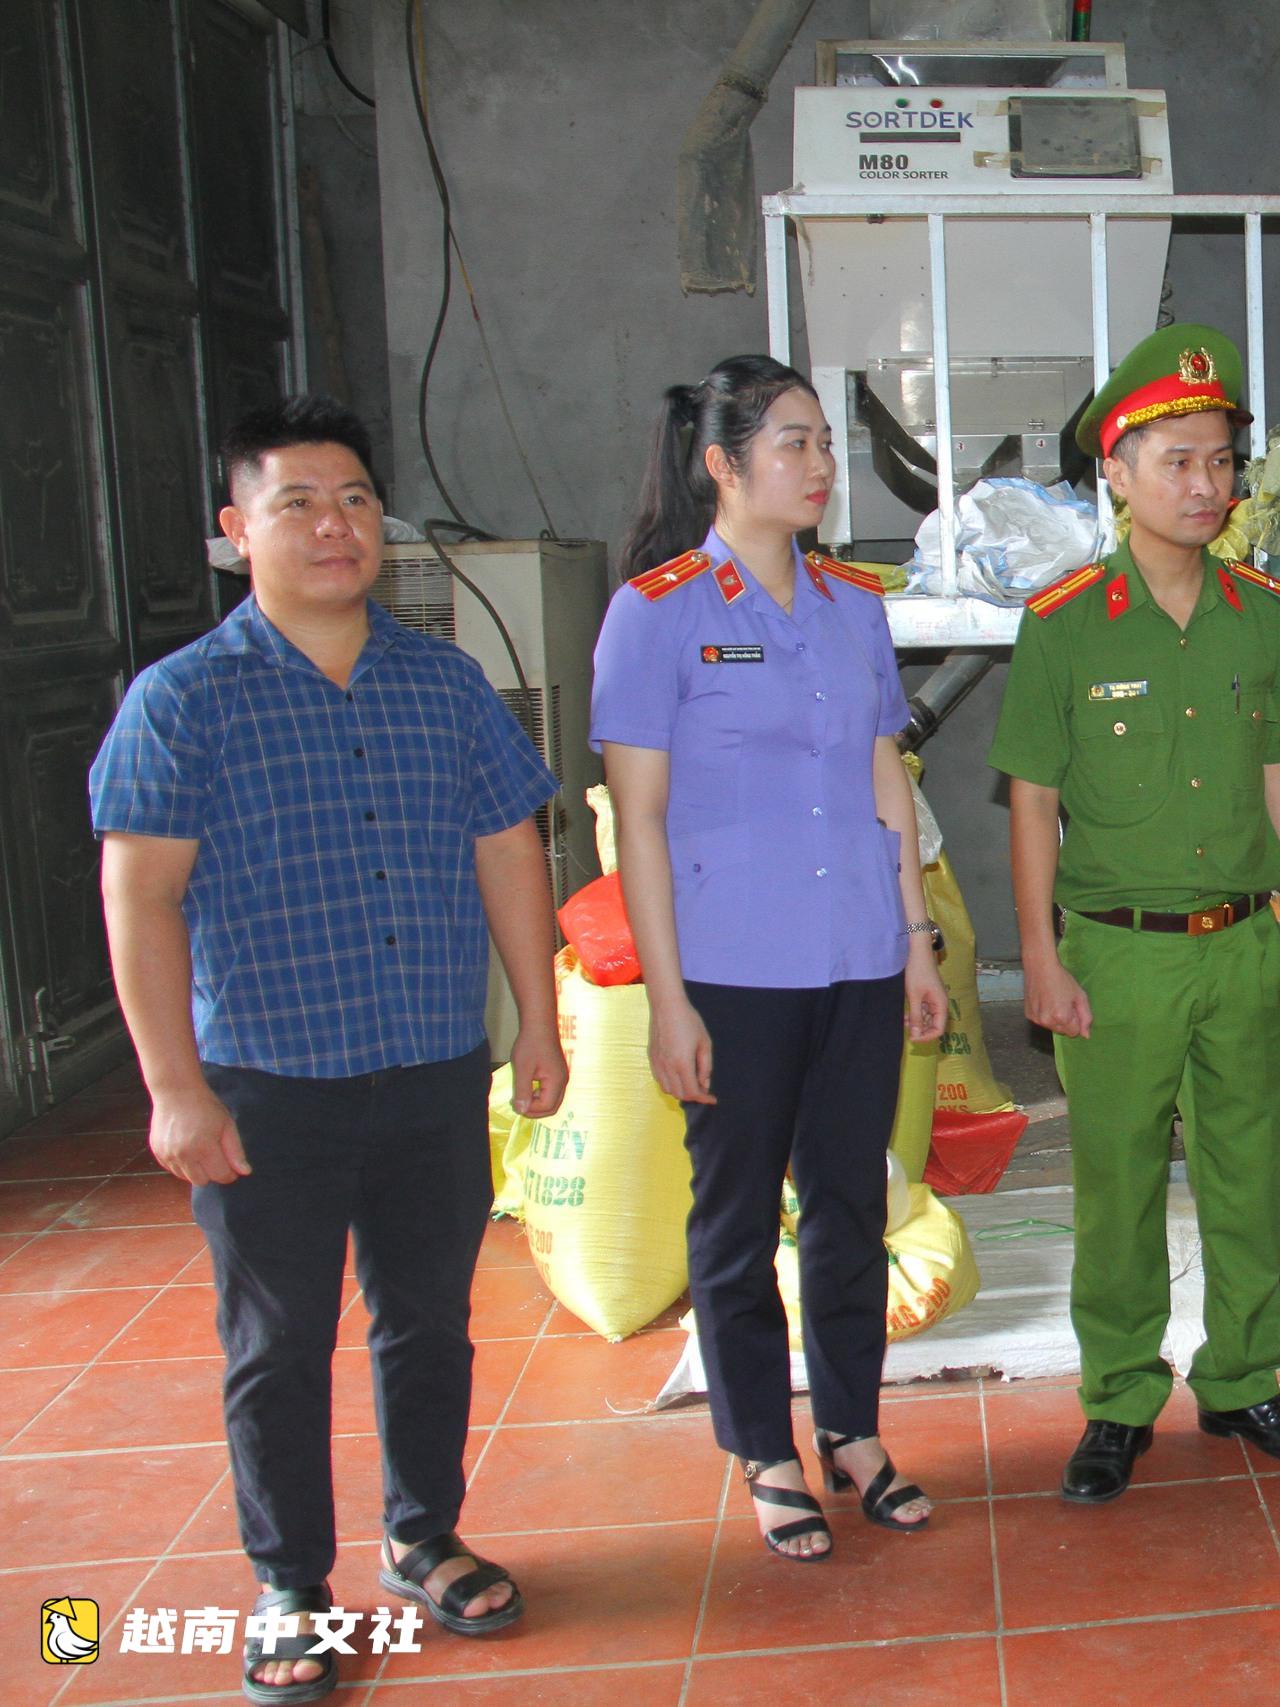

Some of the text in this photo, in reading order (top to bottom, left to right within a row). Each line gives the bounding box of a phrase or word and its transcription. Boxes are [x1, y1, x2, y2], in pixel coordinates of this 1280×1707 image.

[845, 111, 975, 129] SORTDEK
[858, 154, 909, 170] M80
[859, 170, 949, 180] COLOR SORTER
[937, 1083, 968, 1101] 200
